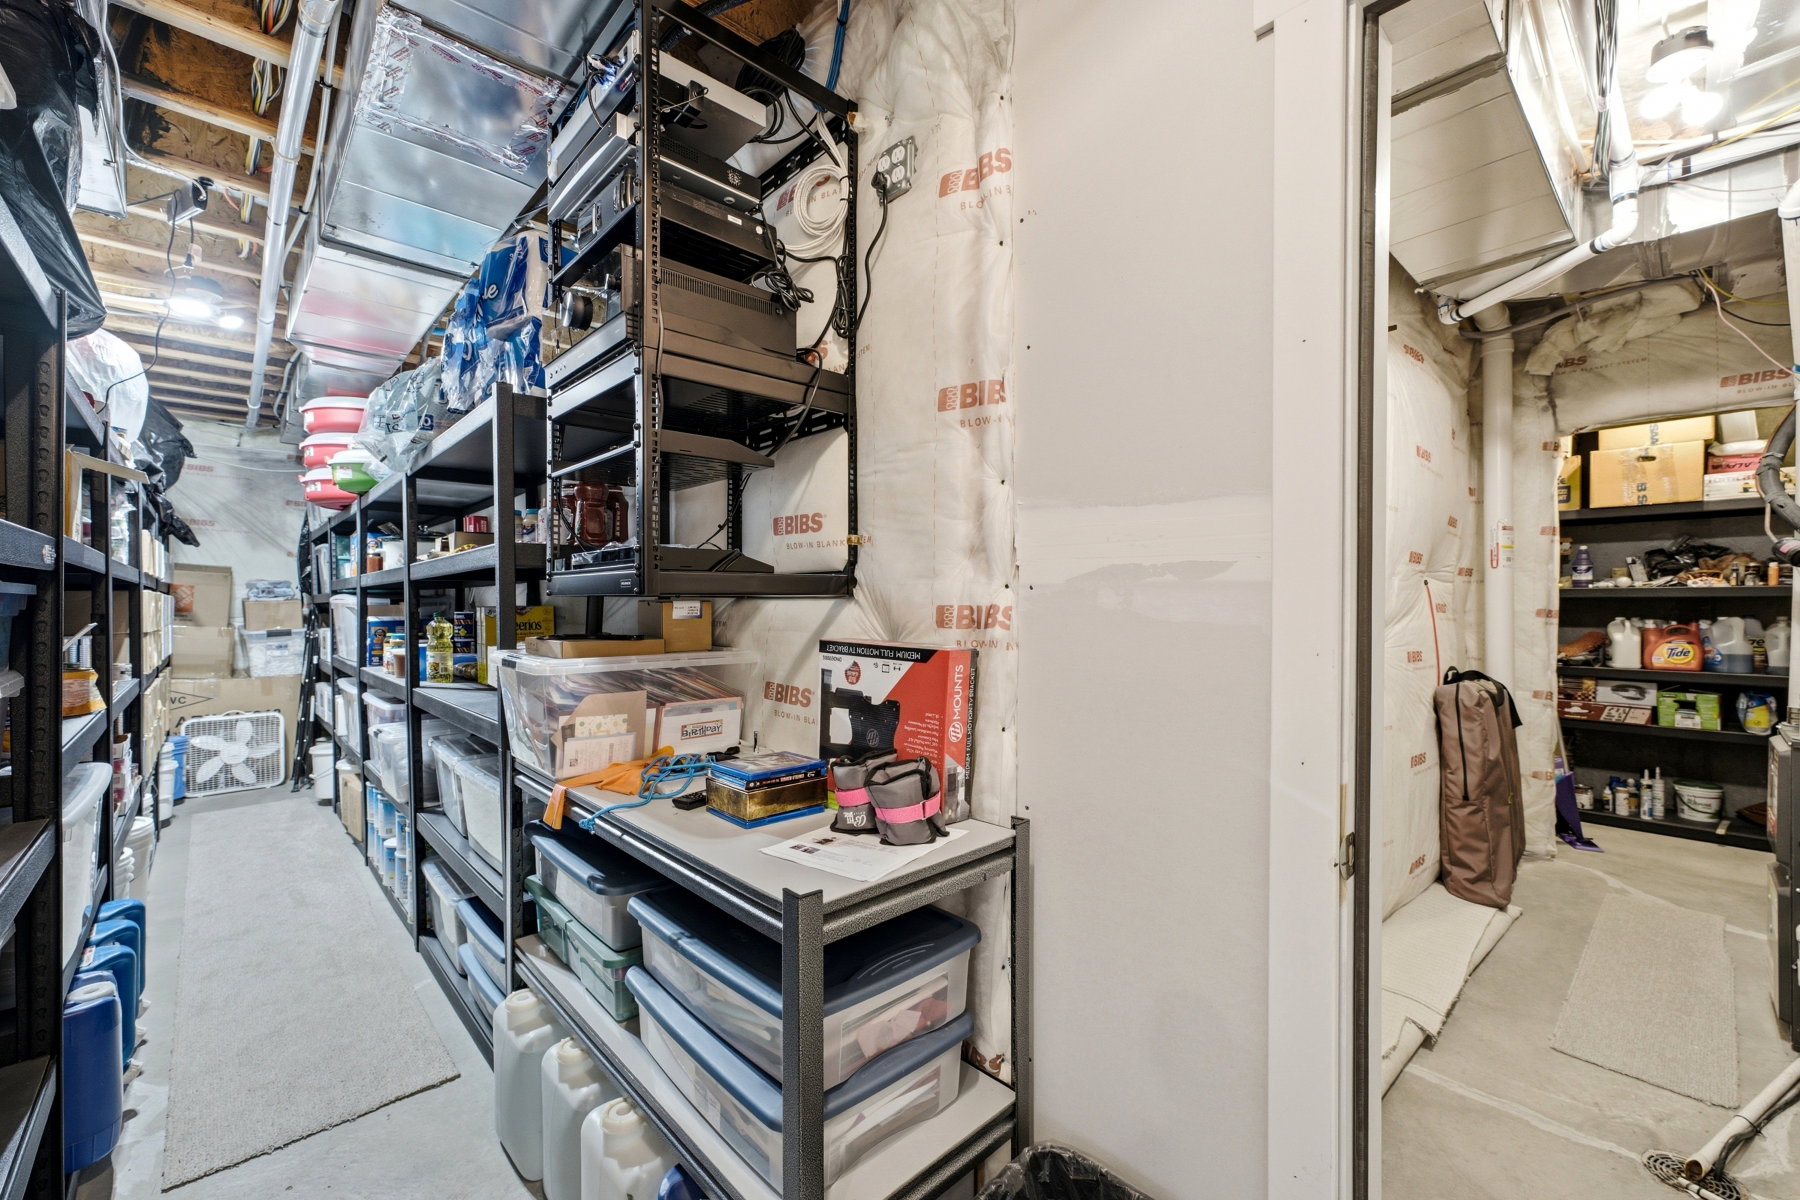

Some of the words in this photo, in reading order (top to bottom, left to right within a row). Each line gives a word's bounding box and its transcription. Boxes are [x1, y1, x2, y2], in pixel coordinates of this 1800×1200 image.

[785, 512, 823, 535] BIBS
[956, 603, 1013, 631] BIBS
[856, 646, 880, 656] MOTION
[880, 649, 894, 658] FULL
[895, 650, 921, 660] MEDIUM
[1666, 647, 1691, 659] Tide
[775, 682, 813, 708] BIBS
[953, 664, 964, 720] MOUNTS
